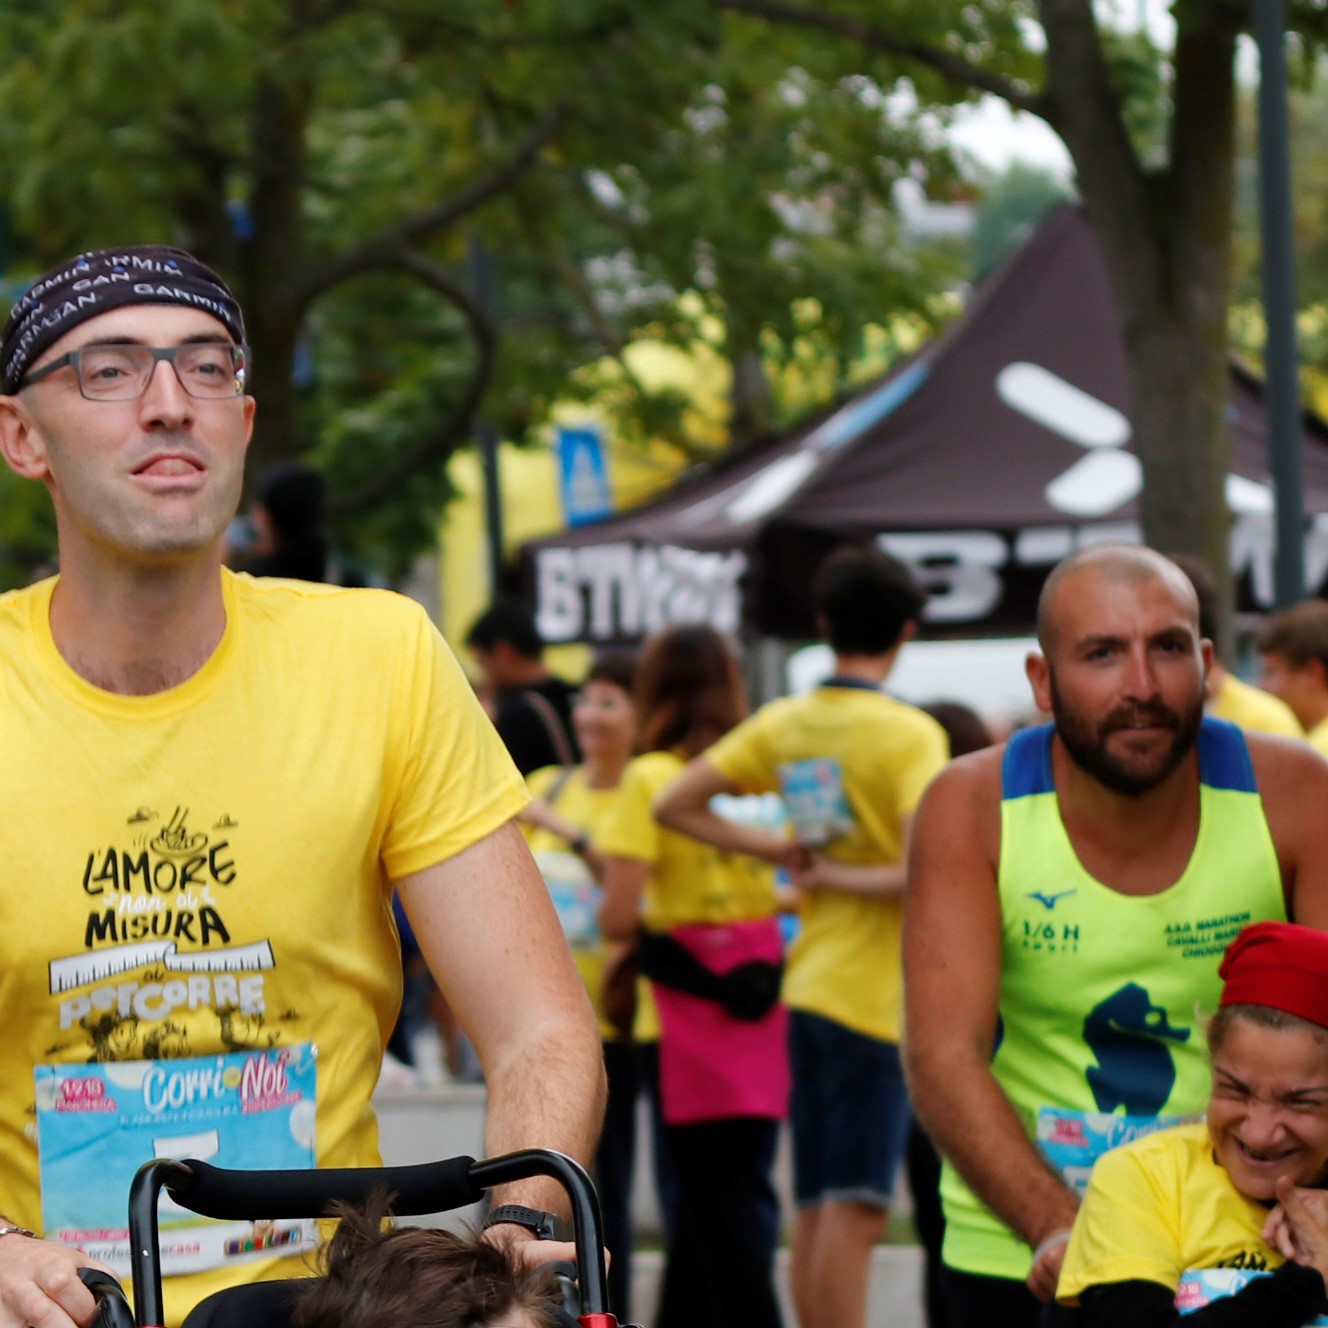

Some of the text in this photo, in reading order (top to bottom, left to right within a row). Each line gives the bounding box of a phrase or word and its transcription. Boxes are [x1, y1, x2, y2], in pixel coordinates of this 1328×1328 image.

[133, 283, 232, 322] GARMIN
[143, 1048, 289, 1113] Corri Noi
